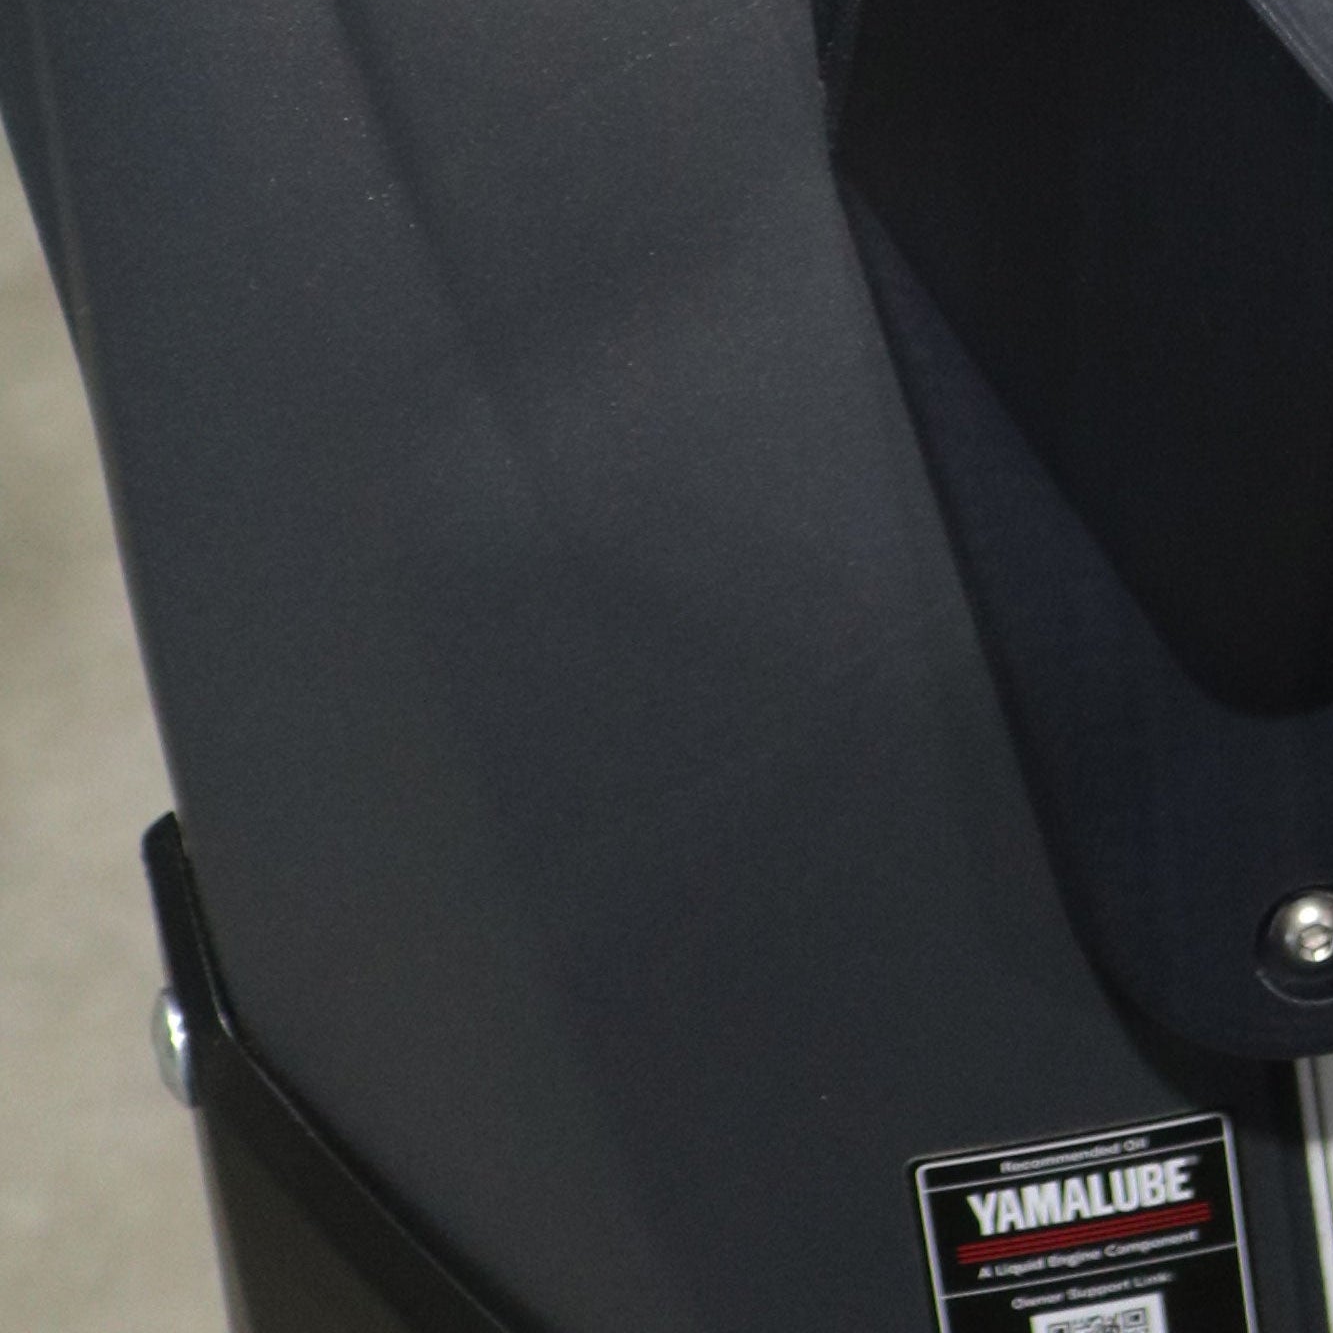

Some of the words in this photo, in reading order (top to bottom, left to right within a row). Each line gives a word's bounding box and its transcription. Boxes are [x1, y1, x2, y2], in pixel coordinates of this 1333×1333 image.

[1000, 1139, 1121, 1173] Recommended
[967, 1158, 1194, 1236] YAMALUBE
[977, 1267, 992, 1280] A
[995, 1257, 1045, 1278] Liquid
[1046, 1247, 1101, 1271] Engine
[1104, 1230, 1198, 1258] Component
